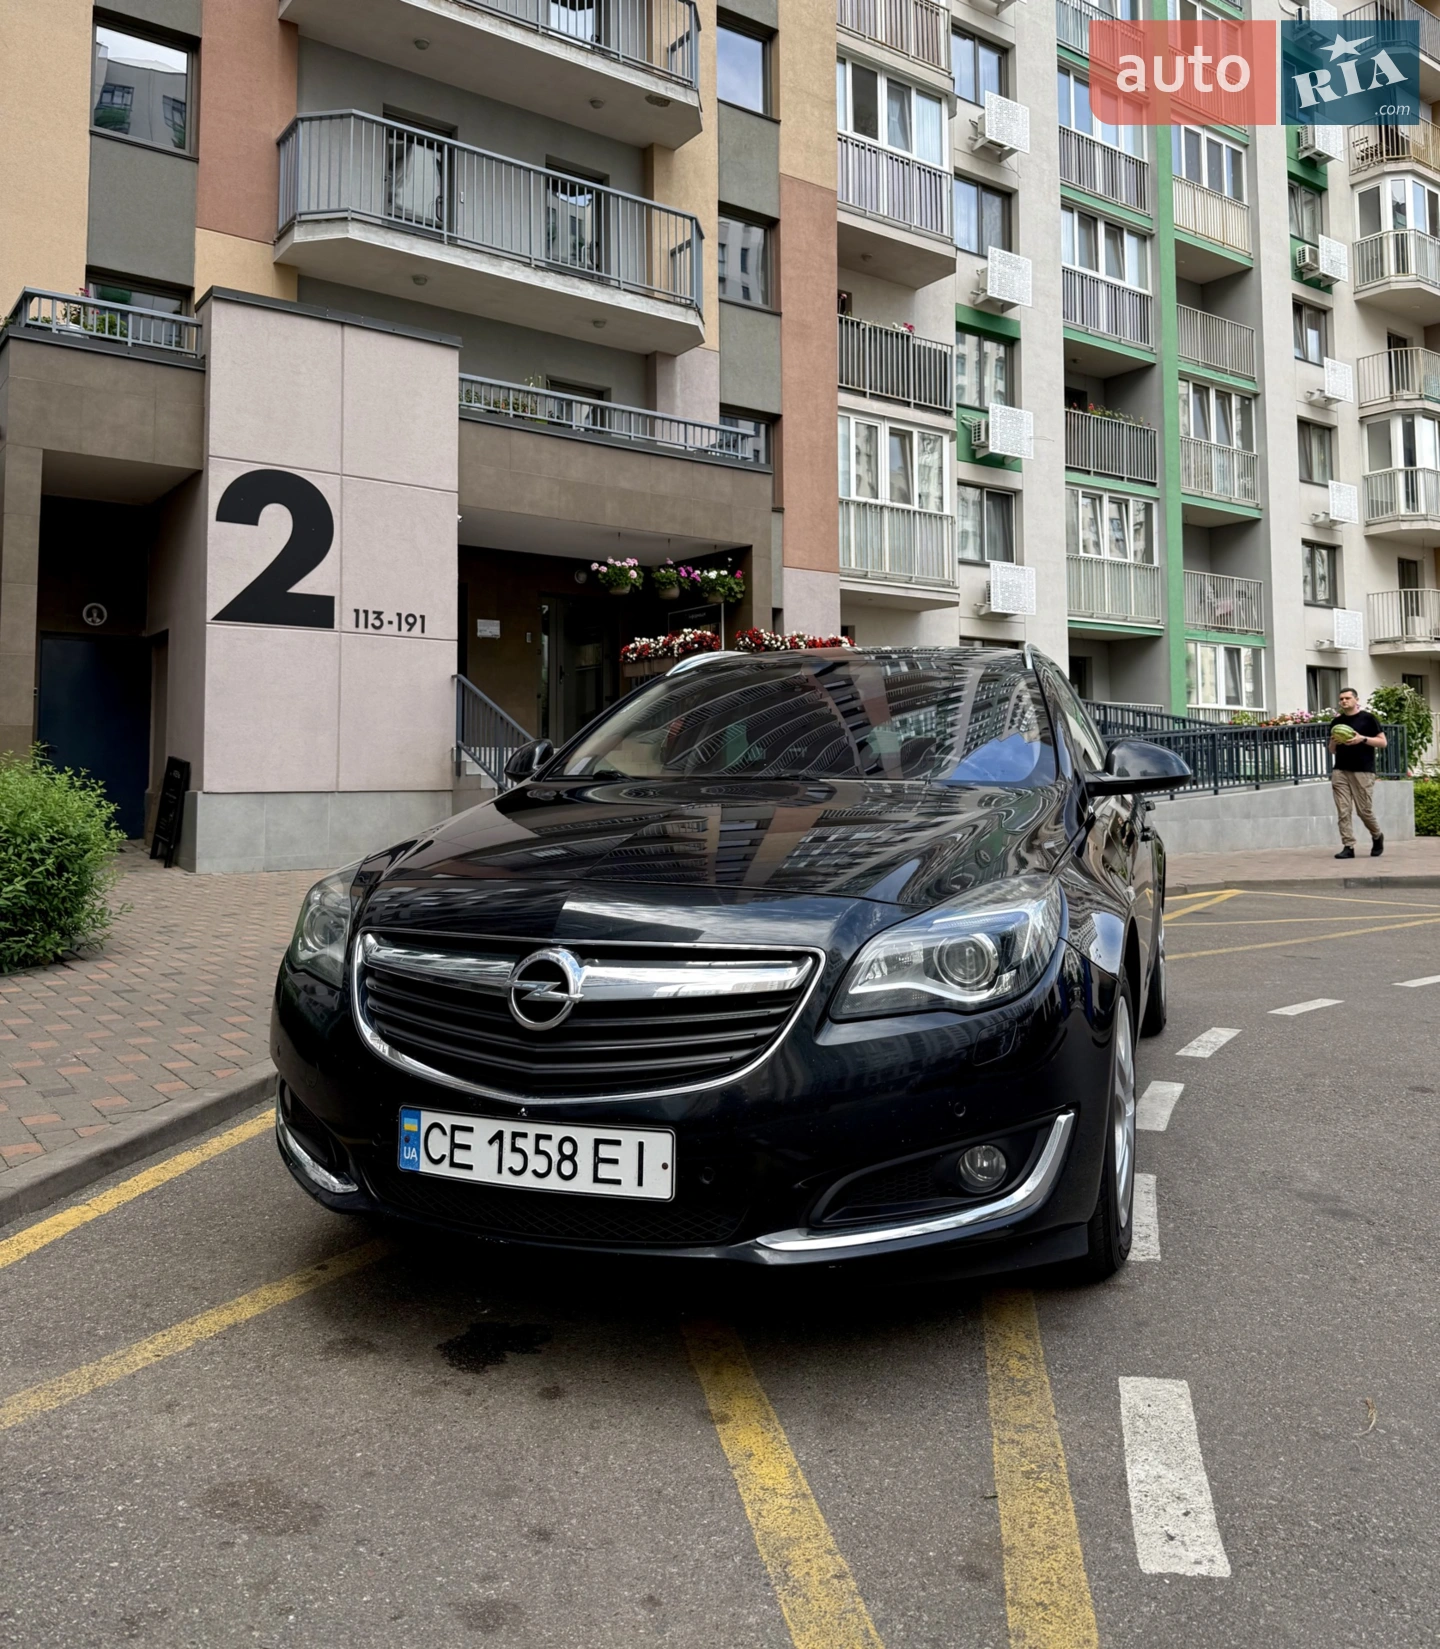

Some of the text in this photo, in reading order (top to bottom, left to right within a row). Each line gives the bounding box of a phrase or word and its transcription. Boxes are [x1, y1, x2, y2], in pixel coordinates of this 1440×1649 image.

[211, 469, 335, 629] 2
[354, 608, 426, 633] 113-191
[403, 1146, 418, 1161] UA
[423, 1121, 645, 1187] CE 1558 EI
